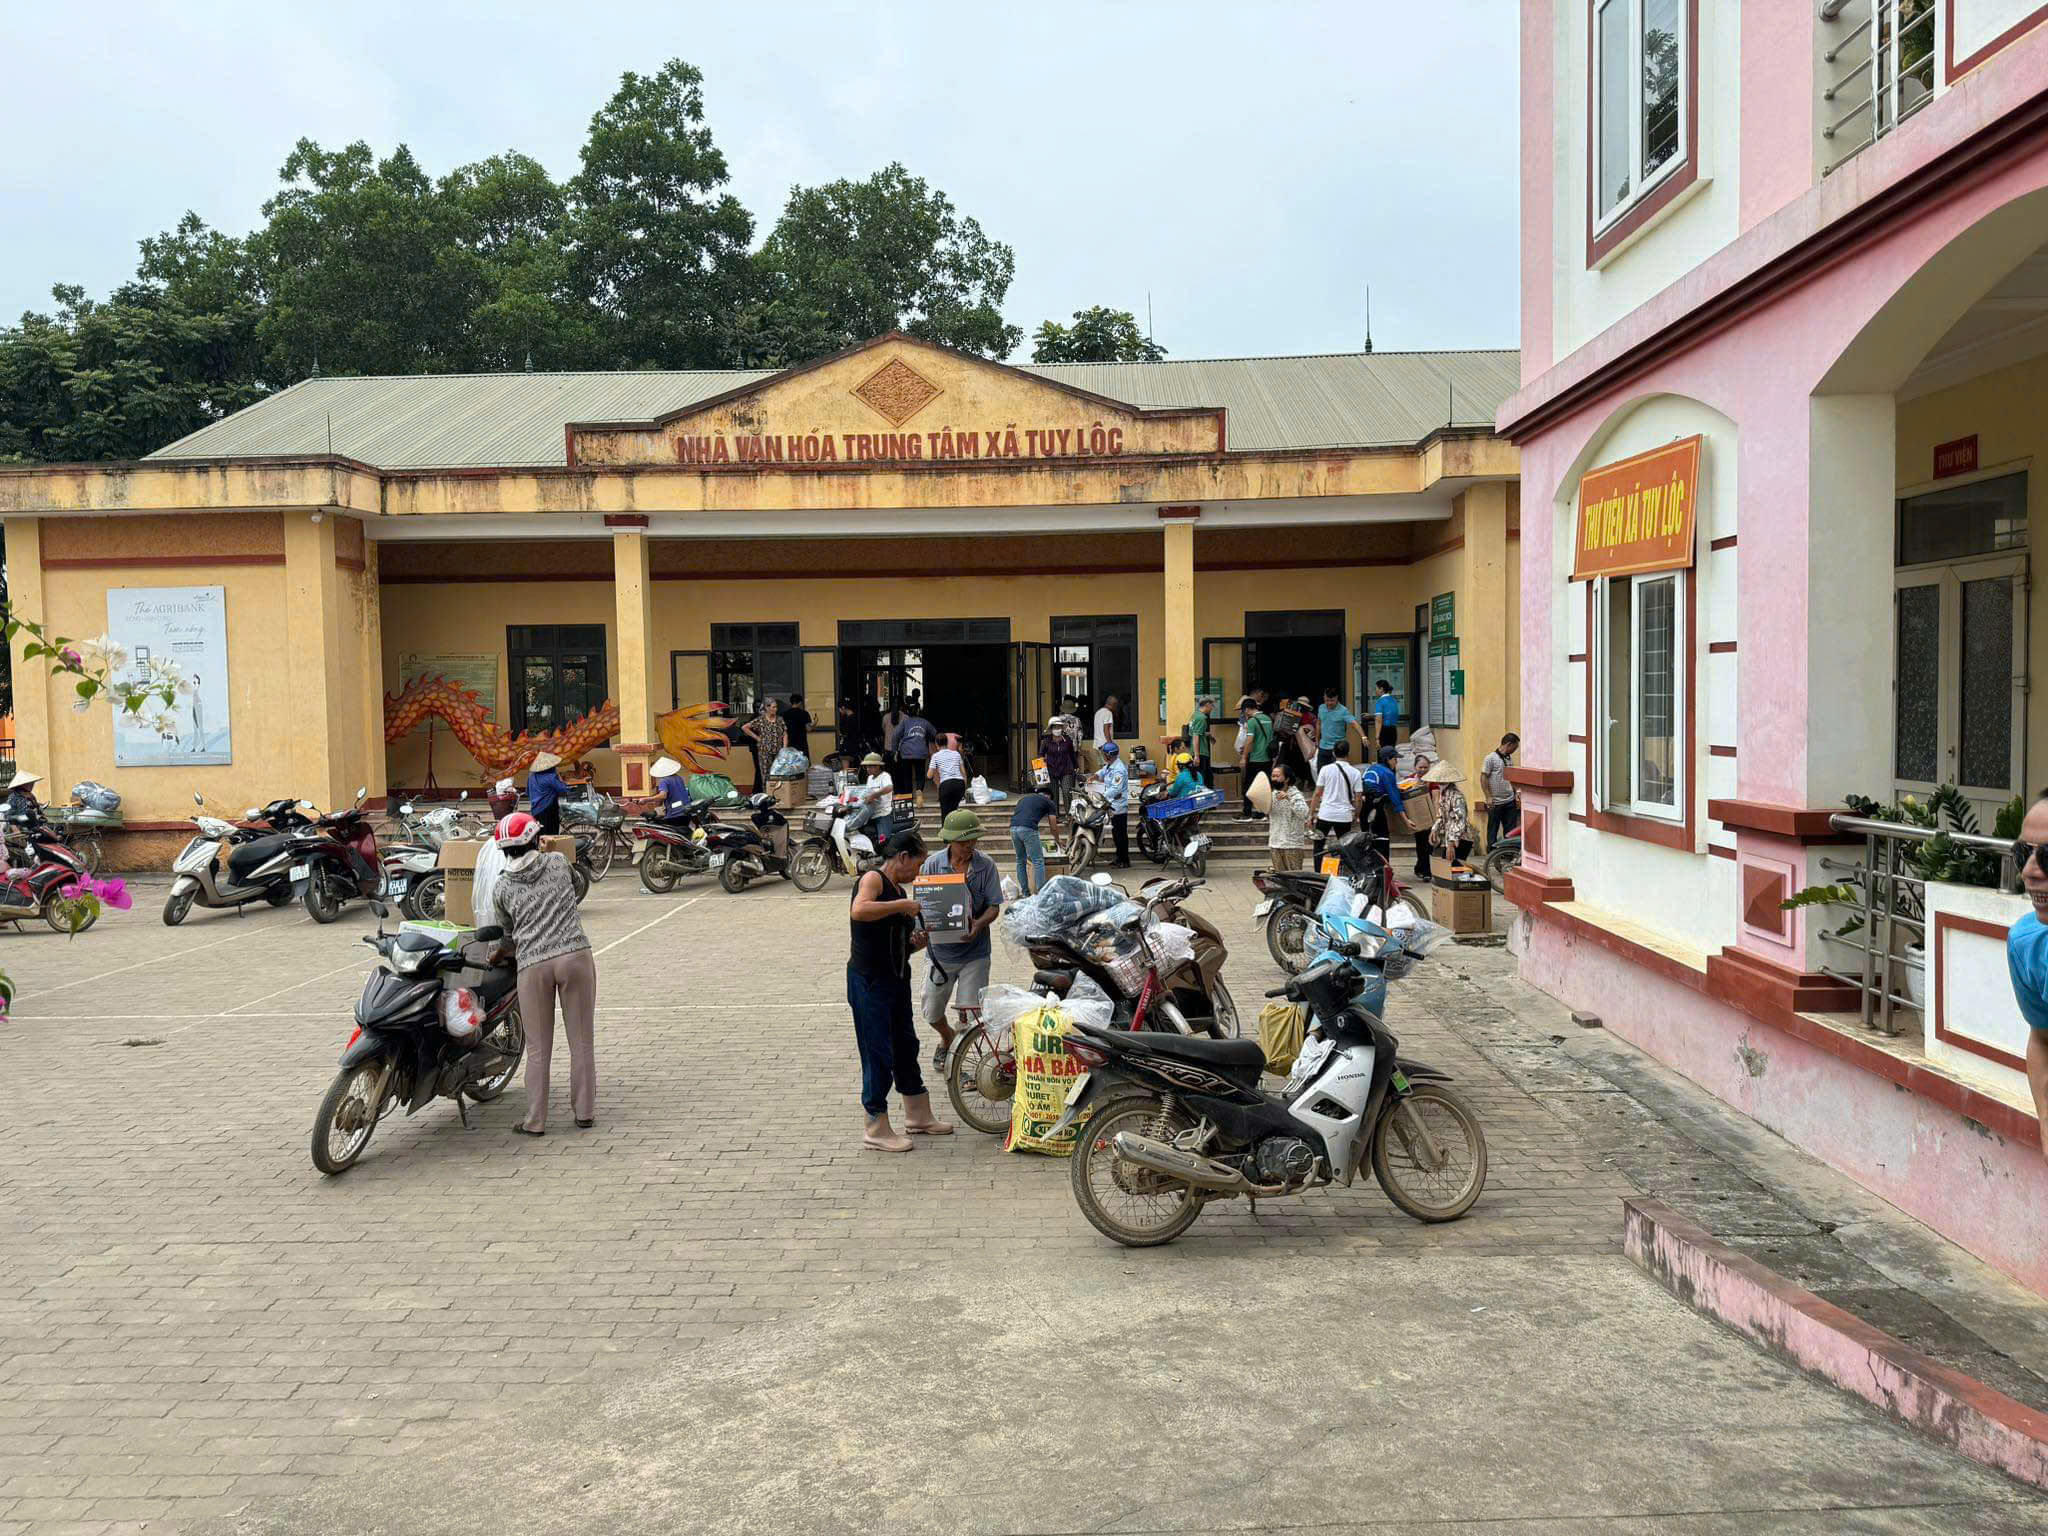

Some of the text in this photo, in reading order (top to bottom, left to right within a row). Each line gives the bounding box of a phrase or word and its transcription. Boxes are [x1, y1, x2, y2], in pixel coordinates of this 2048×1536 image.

[677, 429, 729, 462] NHÀ
[734, 428, 782, 462] VĂN
[788, 427, 837, 461] HÓA
[843, 433, 922, 460] TRUNG
[928, 425, 979, 459] TÂM
[985, 423, 1019, 457] XÃ
[1025, 429, 1071, 456] TUY
[1584, 497, 1604, 551] THƯ
[1602, 488, 1625, 557] VIỆN
[1641, 486, 1662, 541] TUY
[1661, 470, 1685, 547] LỘC
[135, 601, 205, 615] The AGRIBANK
[1337, 1072, 1366, 1081] HONDA
